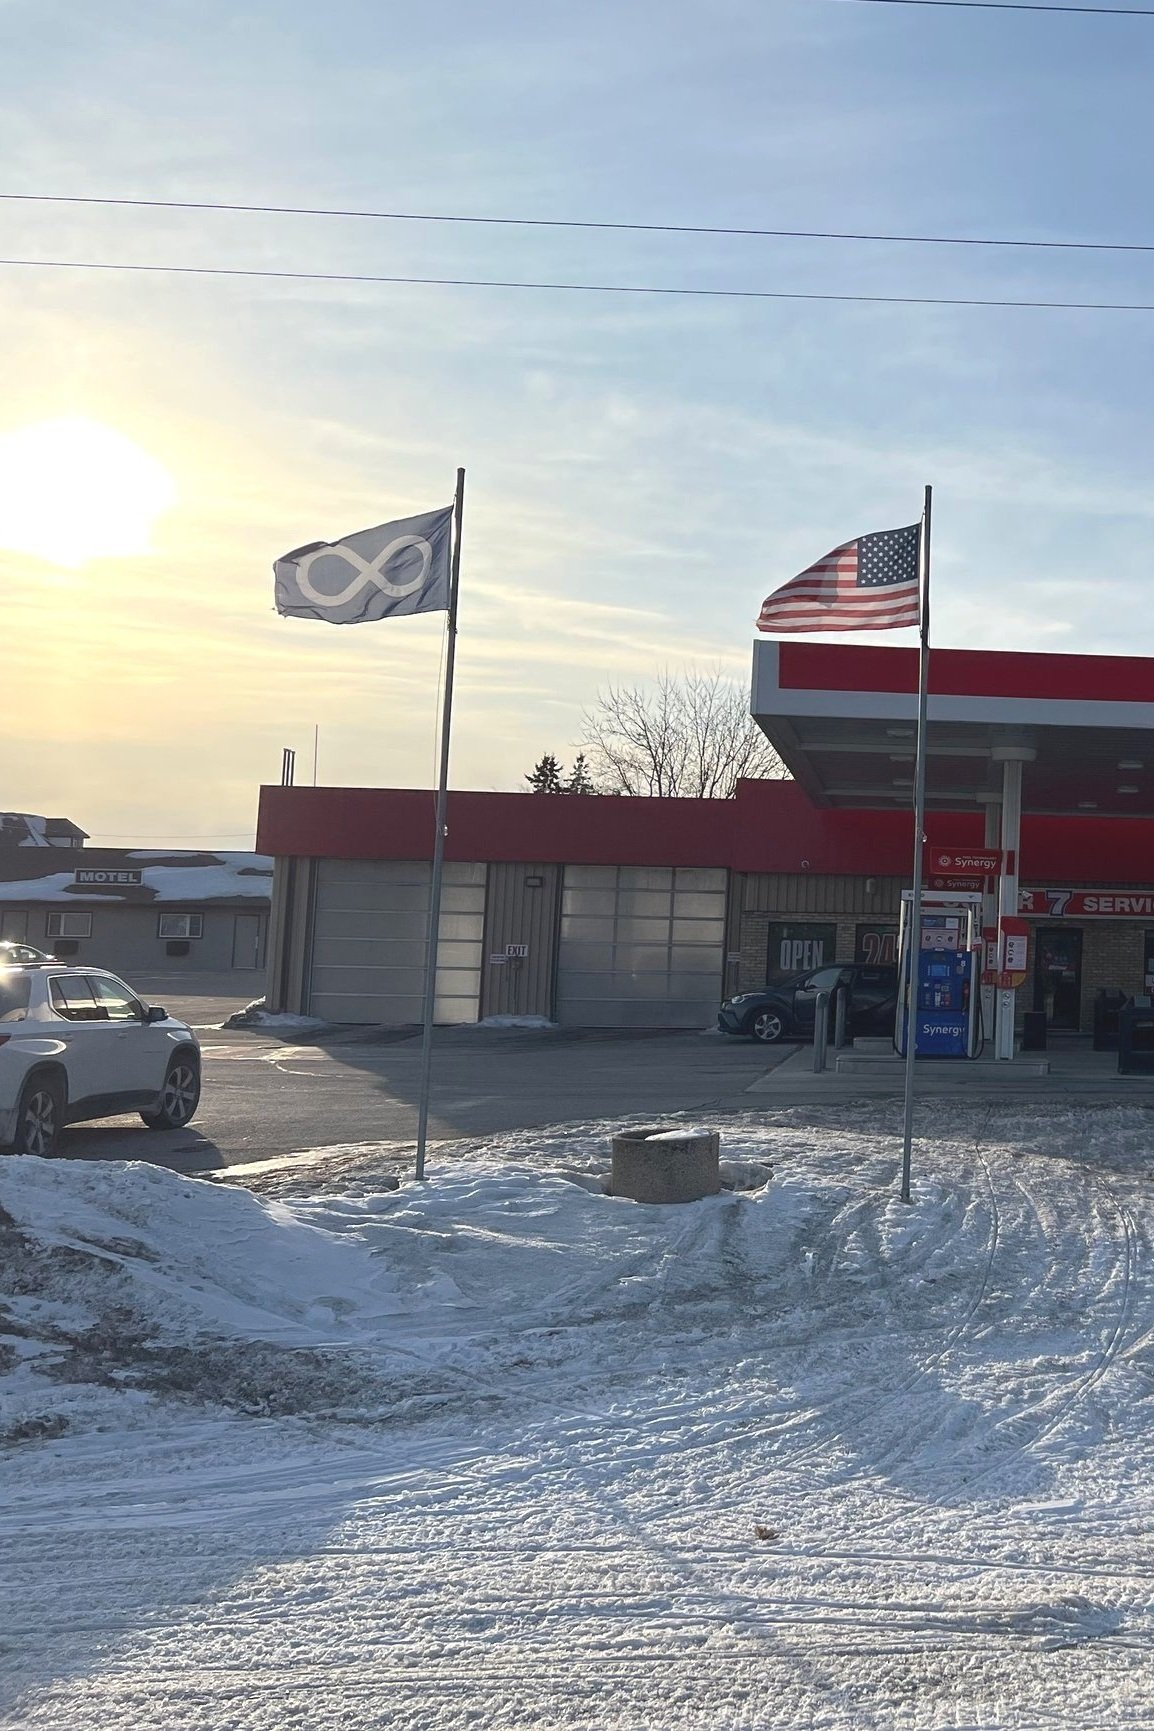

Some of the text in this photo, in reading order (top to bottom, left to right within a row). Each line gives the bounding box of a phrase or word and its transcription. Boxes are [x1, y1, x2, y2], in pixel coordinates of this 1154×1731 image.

[955, 857, 997, 869] Synergy
[80, 871, 138, 882] MOTEL
[1046, 890, 1072, 916] 7
[507, 945, 526, 956] EXIT
[780, 939, 824, 970] OPEN
